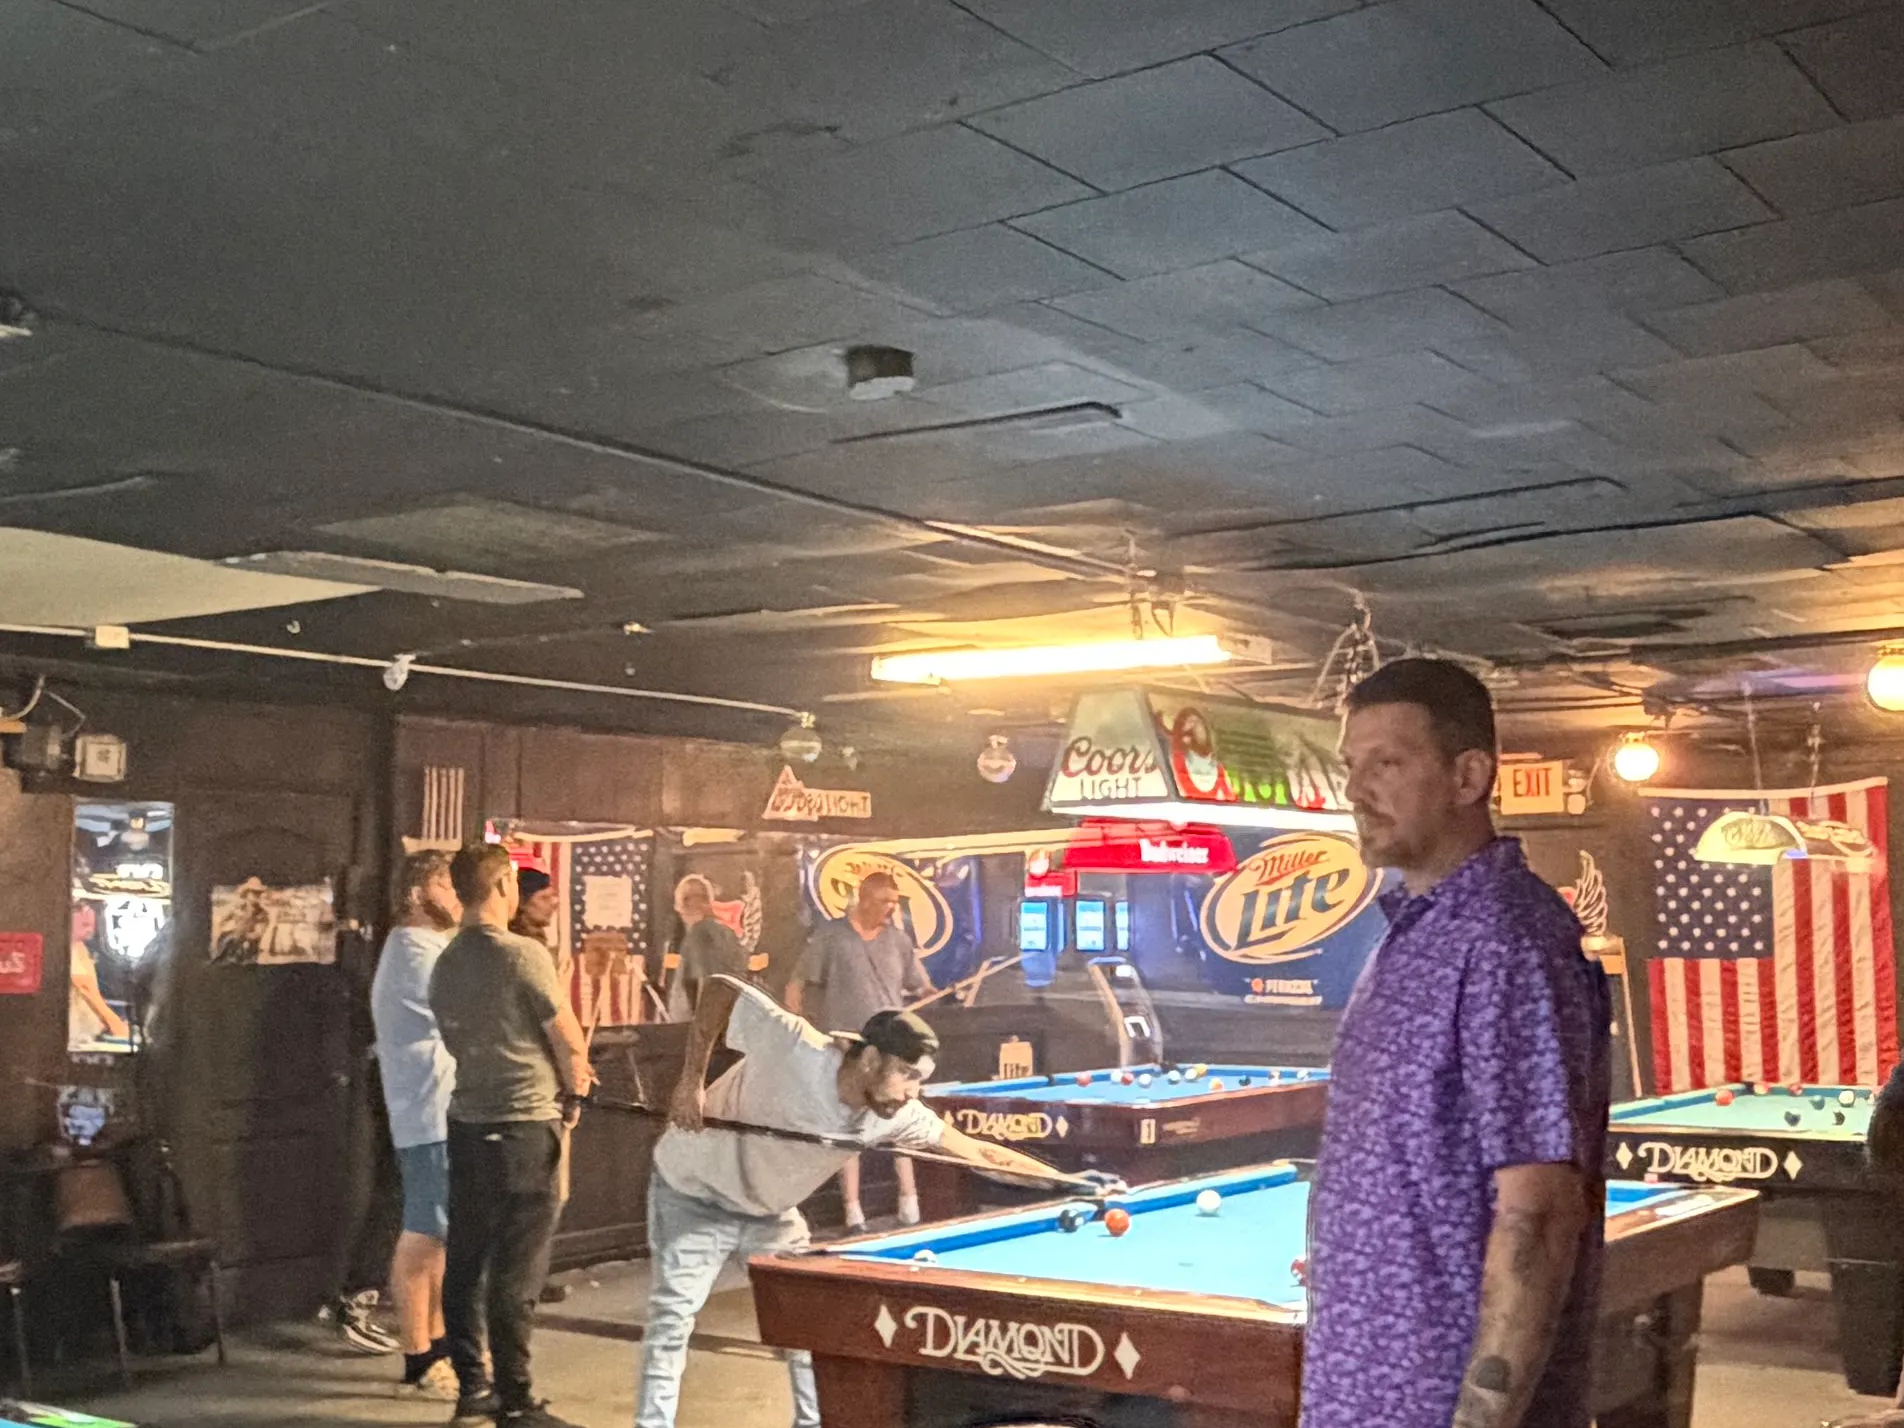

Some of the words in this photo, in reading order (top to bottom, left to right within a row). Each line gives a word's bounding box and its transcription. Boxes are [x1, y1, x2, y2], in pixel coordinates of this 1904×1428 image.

[1063, 736, 1158, 779] Coors
[1080, 776, 1141, 800] LIGHT
[1514, 767, 1552, 798] EXIT
[1248, 848, 1328, 889] Miller
[1229, 868, 1350, 952] Lite
[957, 1109, 1052, 1141] DIAMOND
[1637, 1141, 1778, 1183] DIAMOND
[904, 1306, 1106, 1379] DIAMOND
